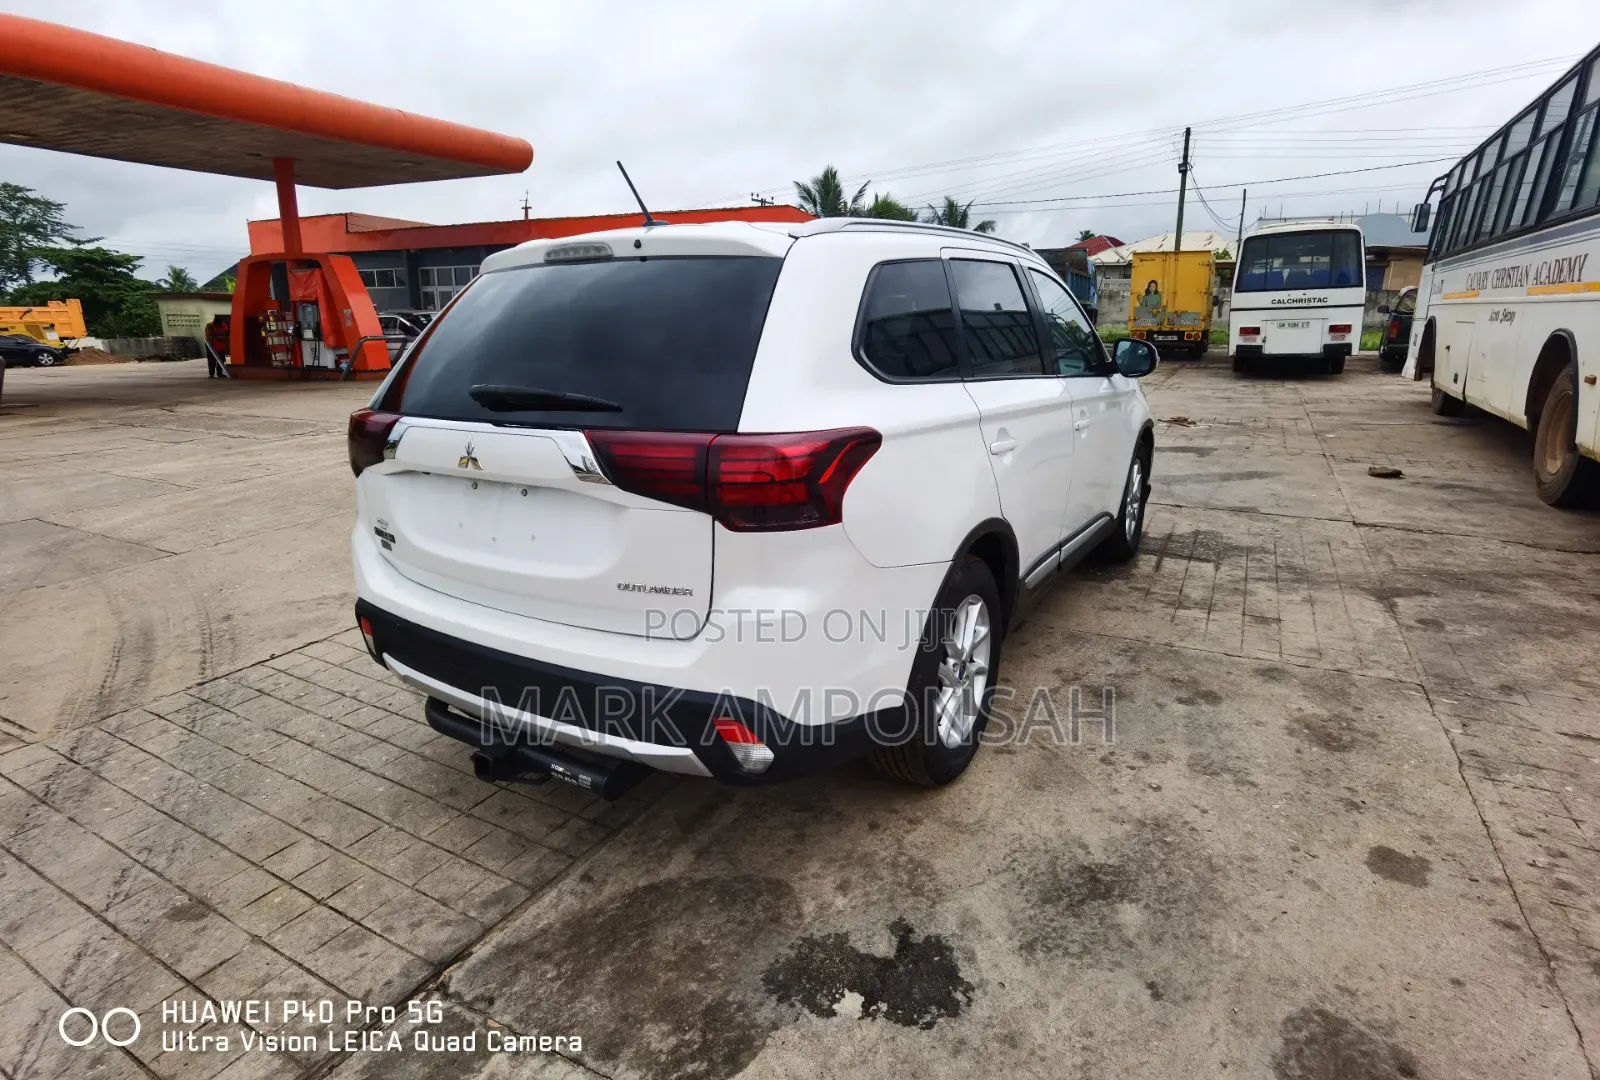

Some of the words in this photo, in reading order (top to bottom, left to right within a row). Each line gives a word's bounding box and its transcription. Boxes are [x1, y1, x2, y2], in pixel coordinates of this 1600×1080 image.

[1492, 264, 1531, 289] CHRISTIAN
[1532, 253, 1589, 286] ACADEMY
[1271, 297, 1328, 305] CALCHRISTAC
[616, 581, 694, 597] OUTLANDER
